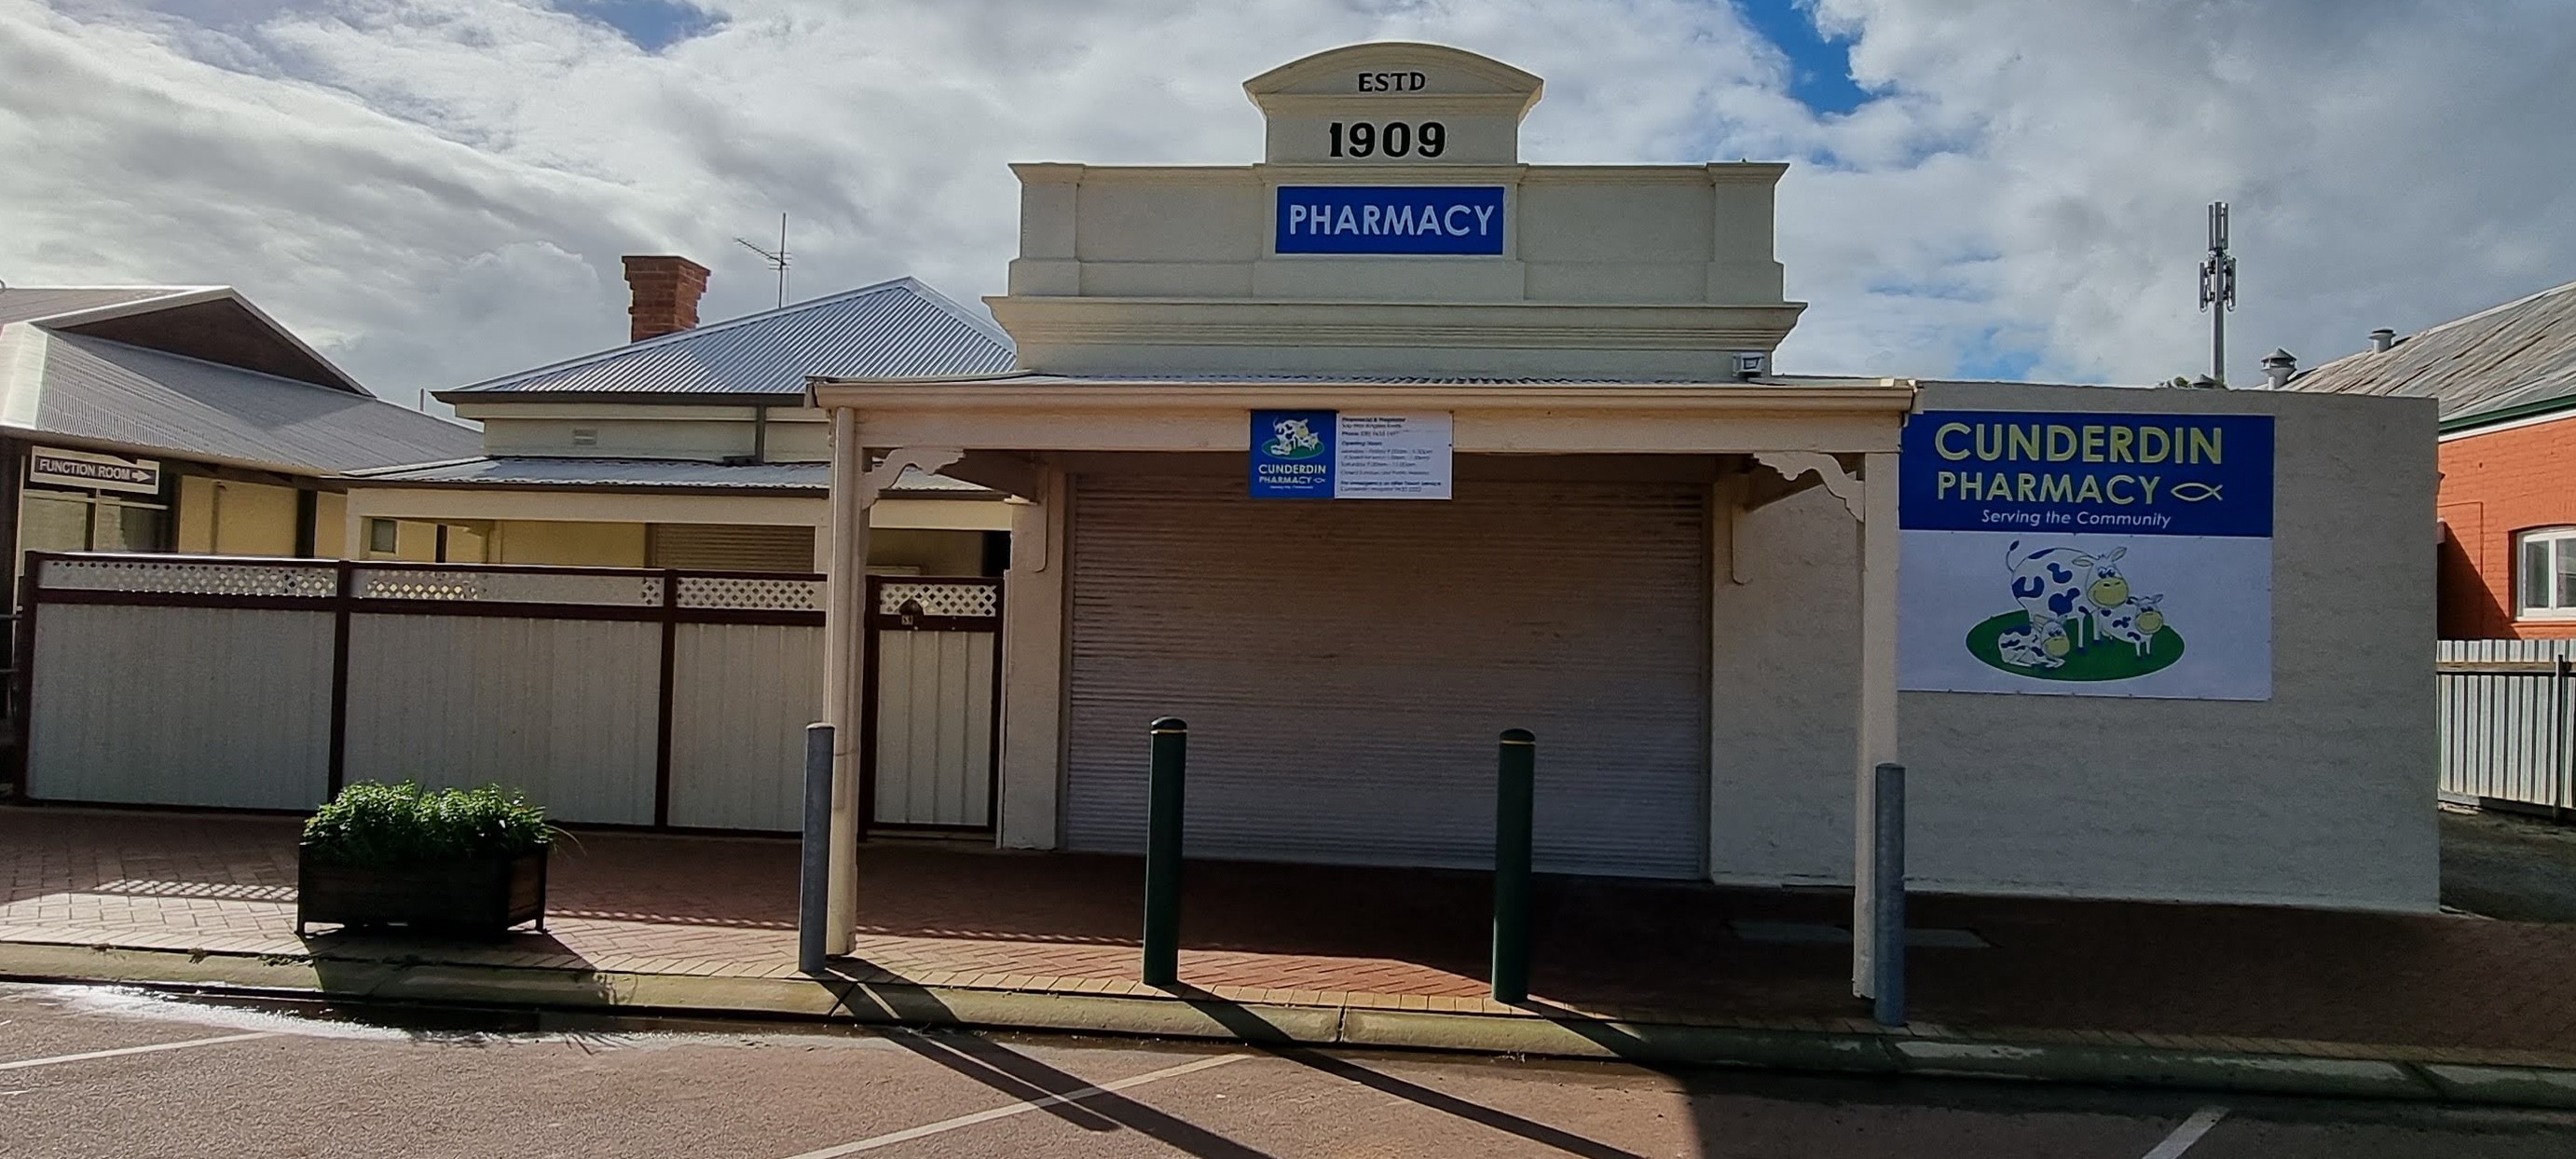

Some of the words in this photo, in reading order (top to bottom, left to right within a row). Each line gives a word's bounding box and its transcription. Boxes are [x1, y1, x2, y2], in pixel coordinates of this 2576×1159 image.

[1358, 72, 1426, 92] ESTD
[1329, 121, 1446, 158] 1909
[1289, 204, 1495, 237] PHARMACY
[1934, 422, 2223, 465] CUNDERDIN
[38, 458, 96, 477] FUNCTION
[98, 466, 130, 480] ROOM
[1258, 464, 1326, 474] CUNDERDIN
[1938, 471, 2161, 505] PHARMACY
[1981, 510, 2041, 526] Serving
[2046, 511, 2071, 524] the
[2076, 511, 2172, 529] Community
